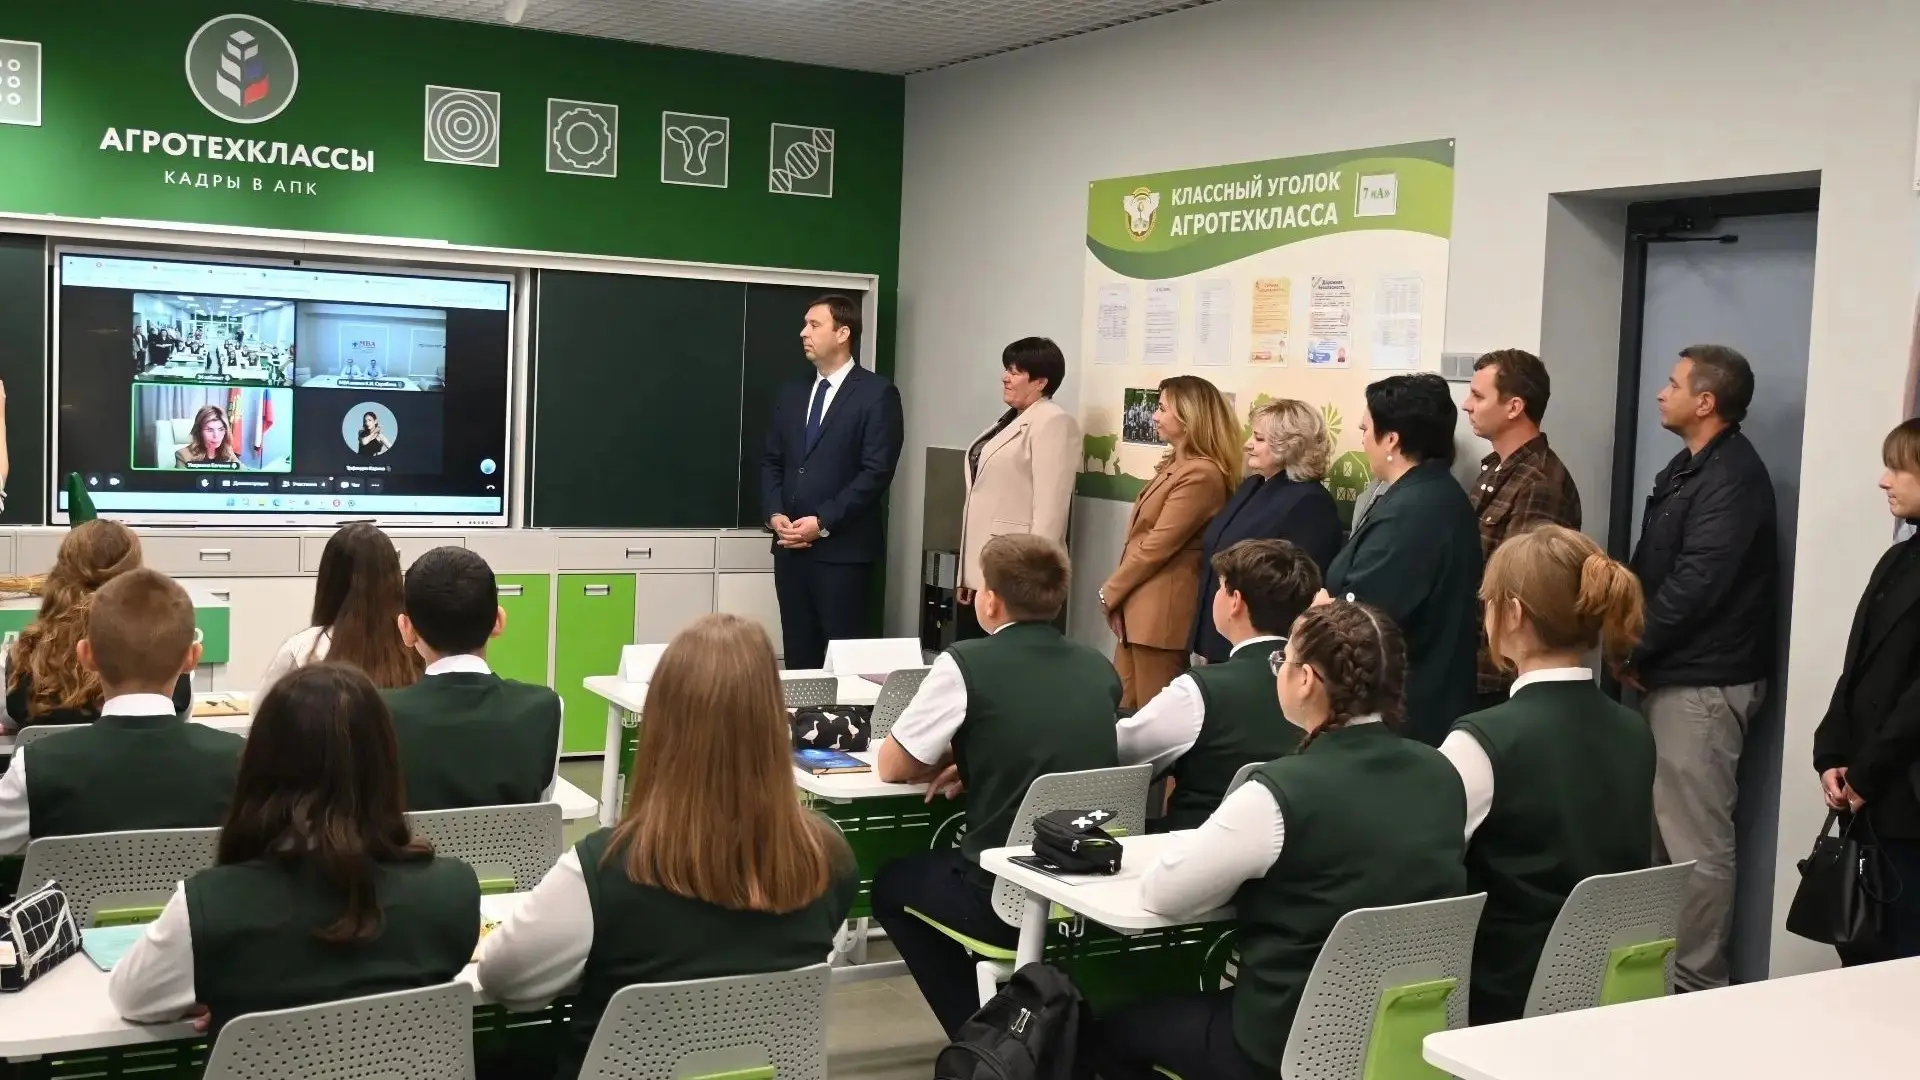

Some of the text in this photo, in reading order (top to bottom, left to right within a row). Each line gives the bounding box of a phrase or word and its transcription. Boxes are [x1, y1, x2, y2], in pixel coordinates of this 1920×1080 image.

[99, 127, 375, 173] АГРОТЕХКЛАССЫ
[164, 170, 319, 196] КАДРЫ В АПК
[1171, 171, 1342, 206] КЛАССНЫЙ УГОЛОК
[1363, 187, 1369, 200] 7
[1170, 202, 1339, 237] АГРОТЕХКЛАССА
